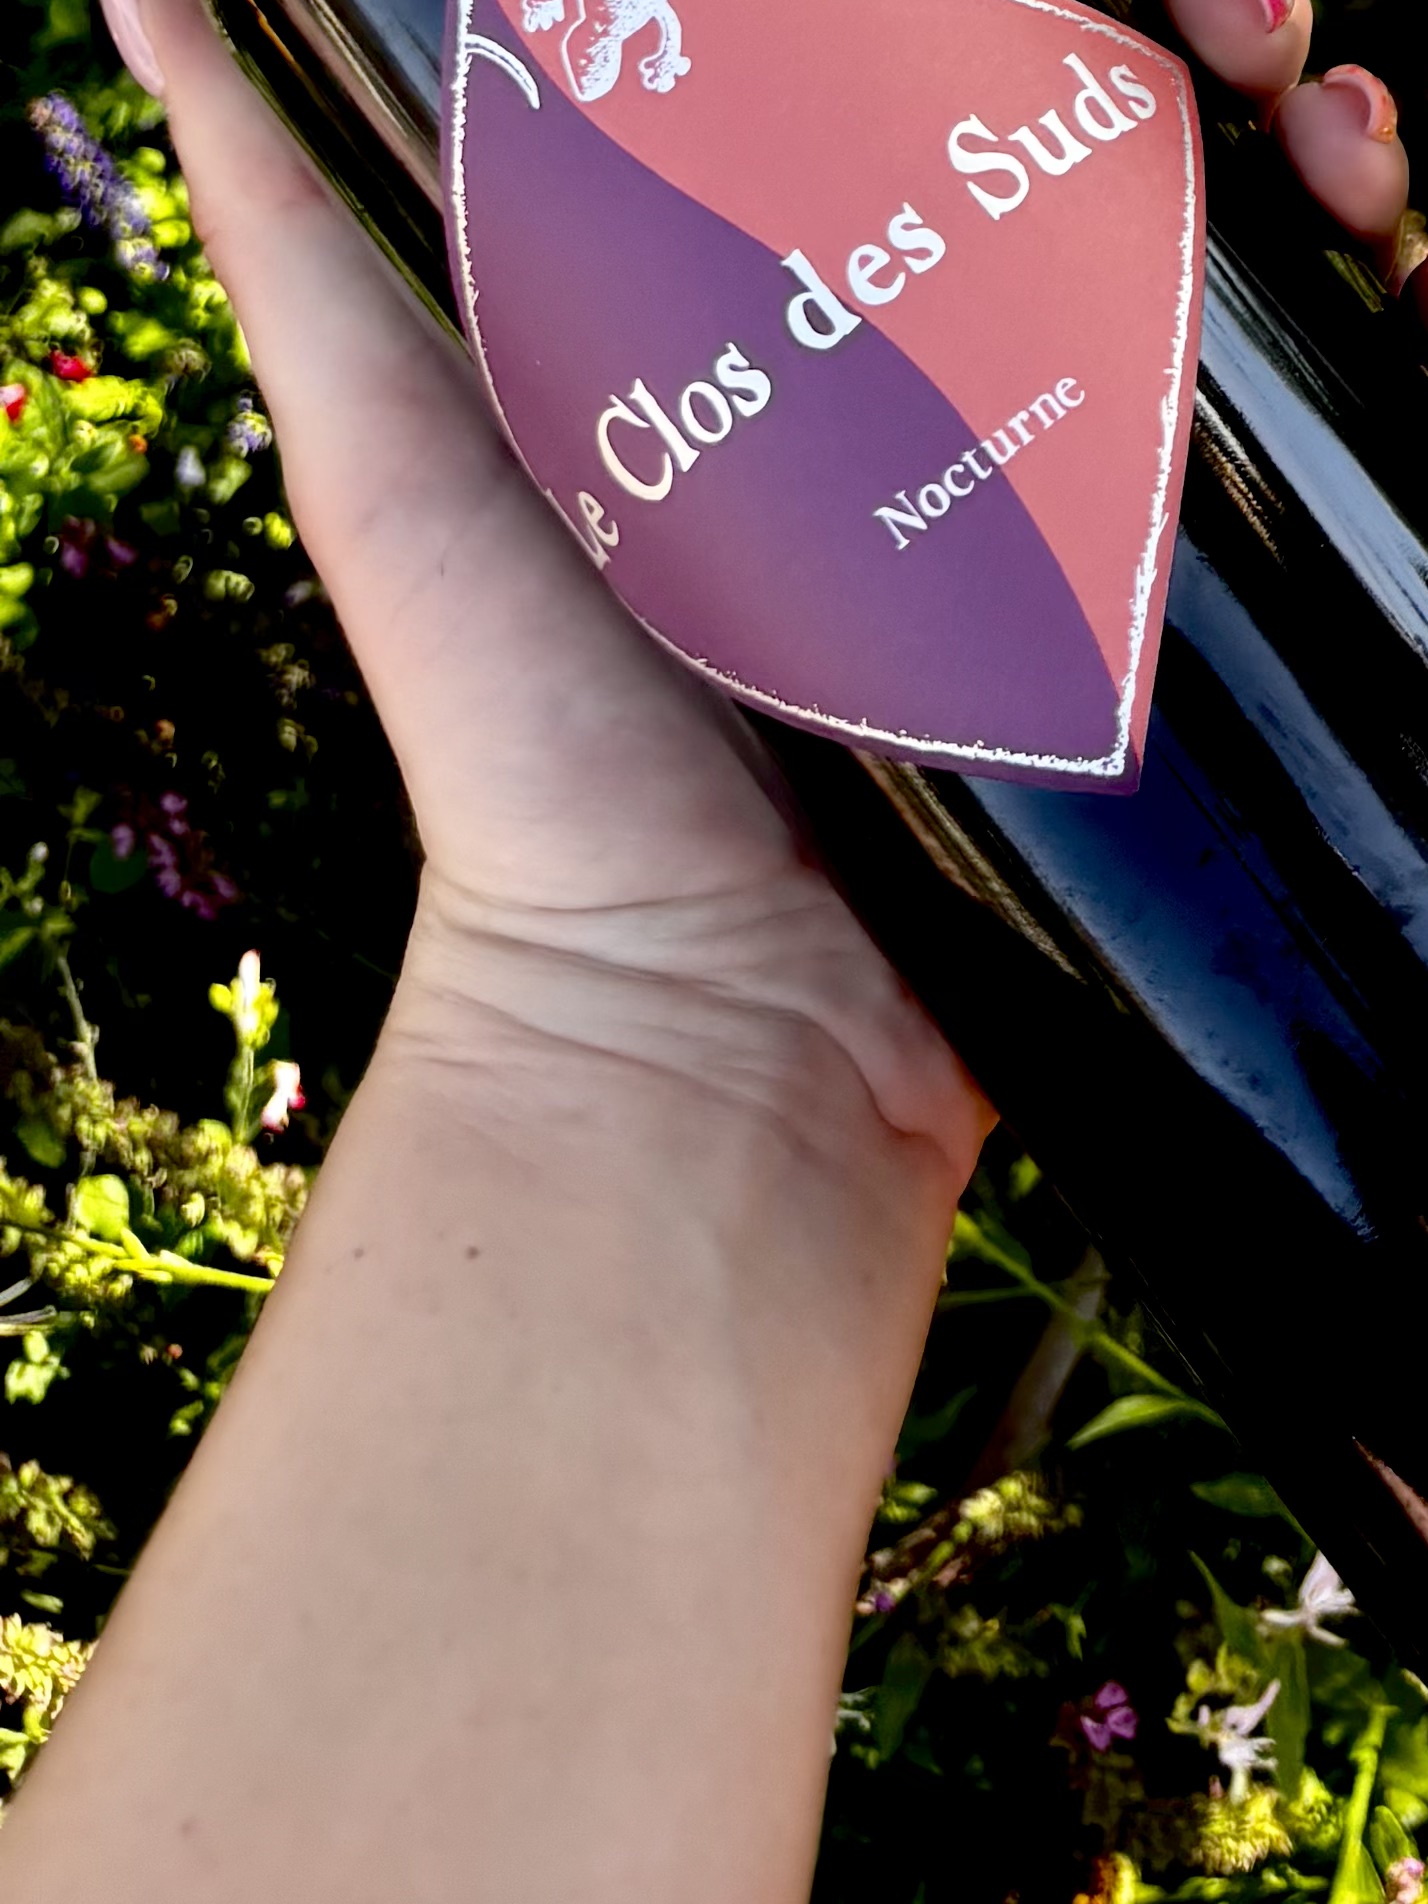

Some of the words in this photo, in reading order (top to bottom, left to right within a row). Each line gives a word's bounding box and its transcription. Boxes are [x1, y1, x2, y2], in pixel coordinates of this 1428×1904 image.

[596, 341, 774, 502] Clos
[781, 200, 948, 351] des
[946, 52, 1159, 221] Suds
[871, 374, 1087, 552] Nocturne
